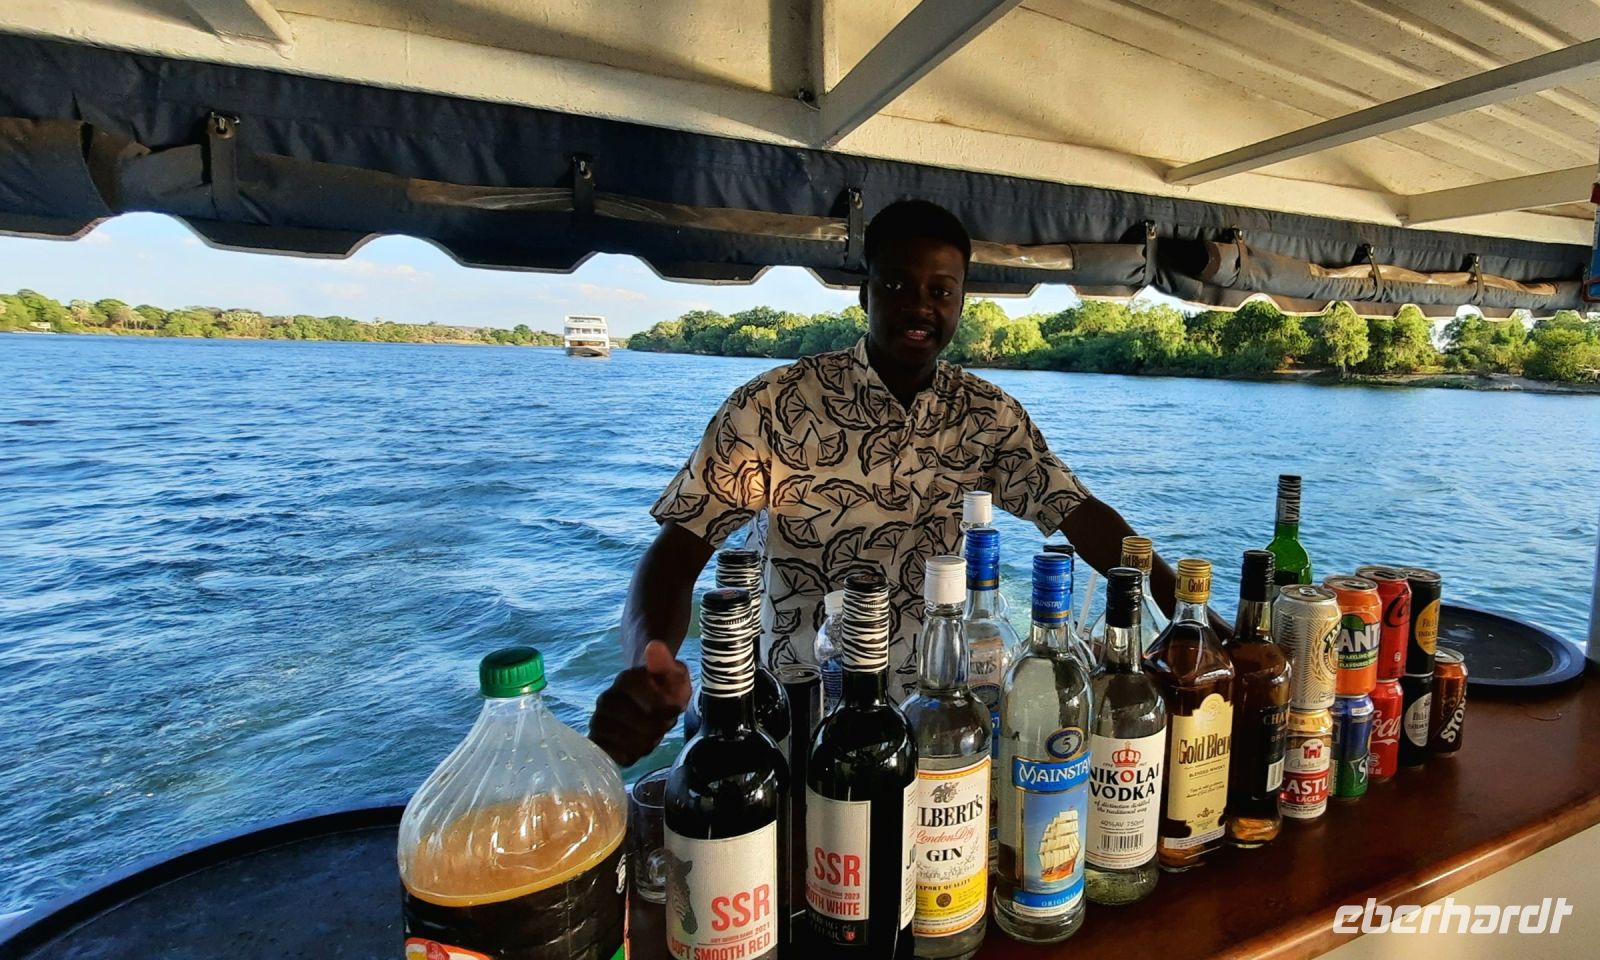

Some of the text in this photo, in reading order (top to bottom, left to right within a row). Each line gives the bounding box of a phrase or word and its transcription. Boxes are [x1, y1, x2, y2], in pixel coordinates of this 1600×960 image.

[1188, 578, 1204, 593] Gold
[1335, 623, 1380, 652] ANT
[1063, 736, 1072, 753] 5
[1178, 733, 1231, 765] Gold Blen
[1089, 762, 1159, 786] NIKOLAI
[1089, 782, 1155, 802] VODKA
[1280, 777, 1329, 796] ASTL
[1295, 794, 1321, 803] LAGER
[916, 794, 983, 828] LBERT'S
[916, 824, 976, 845] London Dry
[926, 846, 963, 862] GIN
[814, 847, 860, 887] SSR
[843, 892, 860, 900] 2023
[711, 884, 770, 933] SSR
[826, 898, 860, 916] WHITE
[693, 943, 745, 960] SMOOTH
[748, 932, 771, 955] RED
